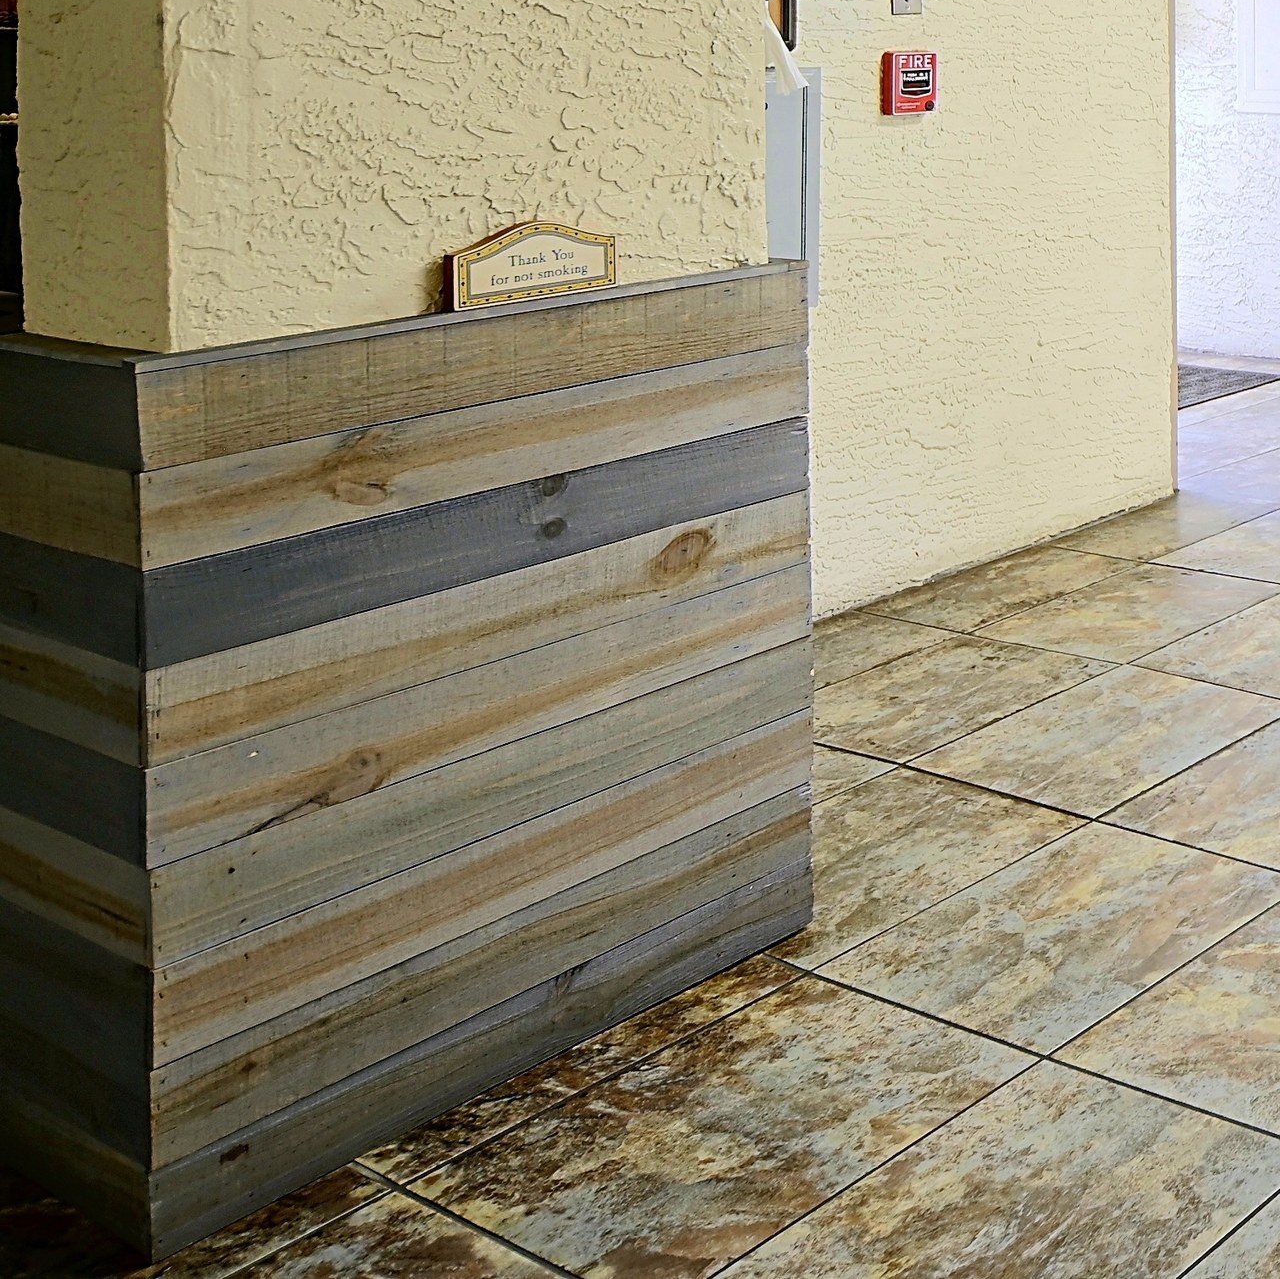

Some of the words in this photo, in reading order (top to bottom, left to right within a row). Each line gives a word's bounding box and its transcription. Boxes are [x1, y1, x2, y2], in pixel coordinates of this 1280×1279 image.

[899, 54, 933, 68] FIRE
[508, 252, 546, 267] Thank
[551, 248, 574, 261] You
[490, 275, 510, 286] for
[514, 273, 534, 283] not
[538, 264, 588, 279] smoking
